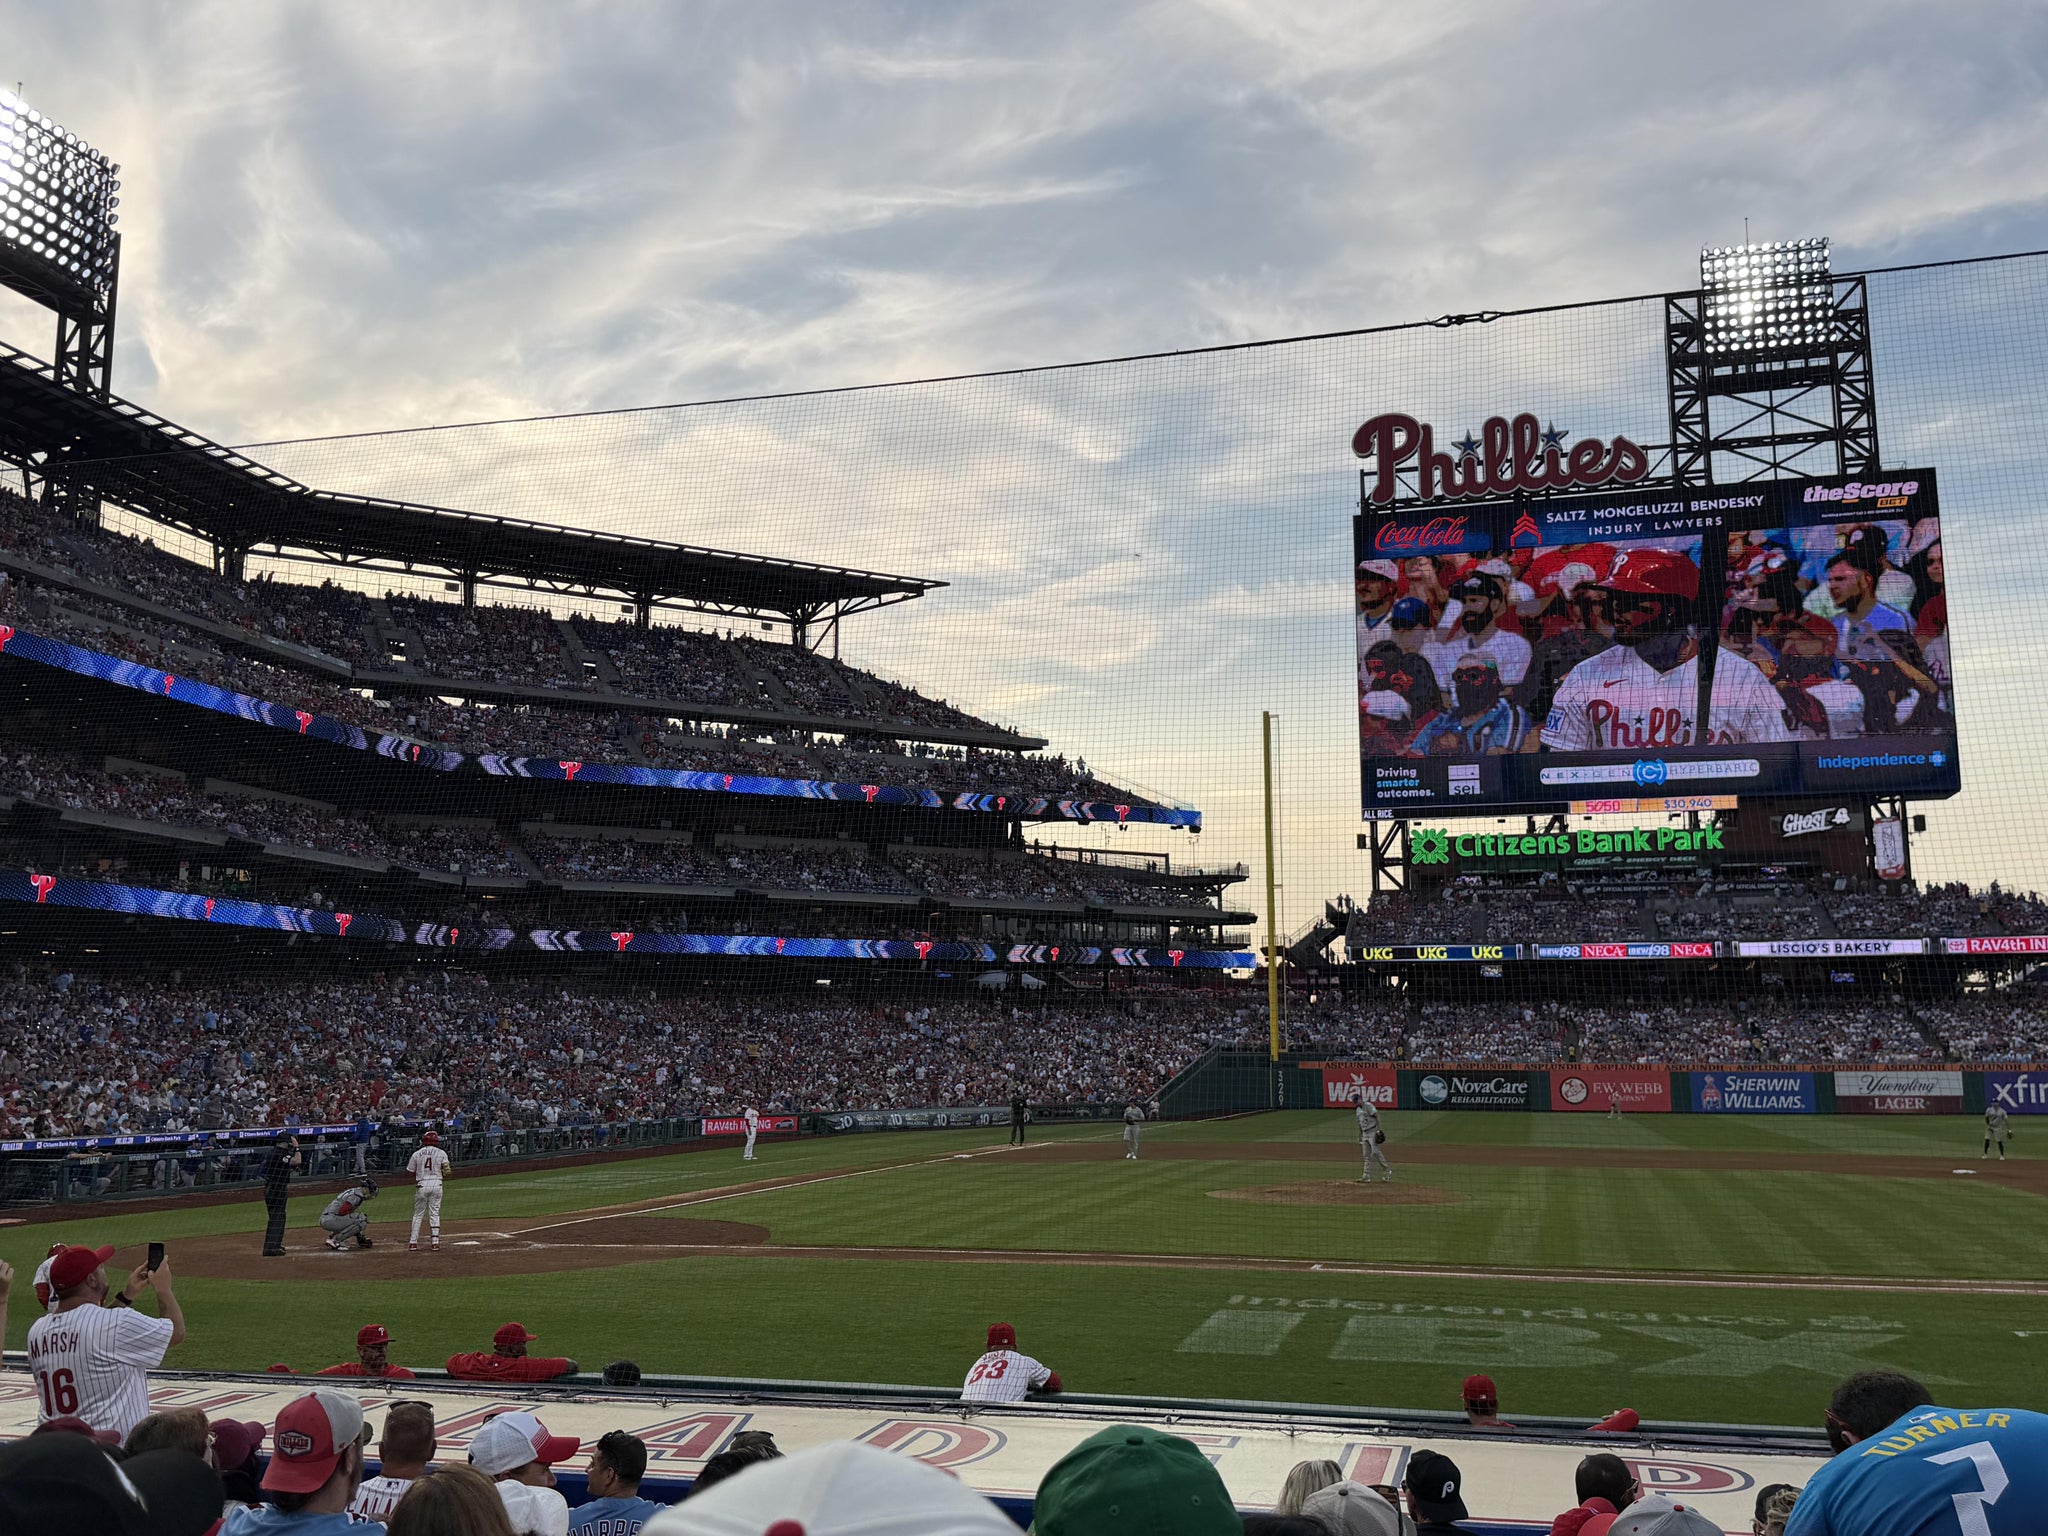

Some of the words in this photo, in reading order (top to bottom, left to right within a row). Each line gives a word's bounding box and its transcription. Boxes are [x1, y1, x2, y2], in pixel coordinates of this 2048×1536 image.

[1352, 412, 1650, 505] Phillies
[1803, 481, 1919, 503] theScore
[1546, 510, 1586, 524] SALTZ
[1594, 501, 1684, 520] MONGELUZZI
[1690, 495, 1764, 512] BENDESKY
[1588, 523, 1642, 536] INJURY
[1654, 516, 1722, 530] LAWYERS
[1670, 762, 1758, 774] HYPERBARIC
[1818, 753, 1926, 769] Independence
[1376, 768, 1417, 778] Driving
[1376, 778, 1420, 788] smarter
[1377, 788, 1435, 798] outcomes.
[1664, 798, 1712, 809] $30,940
[1363, 810, 1376, 818] ALL
[1782, 808, 1836, 837] GHOST
[1455, 831, 1570, 858] Citizens
[1577, 826, 1652, 854] Bank
[1657, 824, 1724, 851] Park
[1362, 948, 1394, 960] UKG
[1416, 947, 1448, 960] UKG
[1471, 946, 1503, 960] UKG
[1584, 946, 1624, 957] NECA
[1674, 944, 1712, 956] NECA
[1770, 944, 1829, 953] LISCIO'S
[1834, 942, 1890, 952] BAKERY
[1970, 938, 2026, 952] RAV4th
[2030, 938, 2048, 951] IN
[1328, 1081, 1393, 1103] Wawa
[1450, 1077, 1528, 1094] NovaCare
[1620, 1082, 1662, 1094] WEBB
[1725, 1076, 1800, 1092] SHERWIN
[1858, 1075, 1938, 1094] Yuengling
[1450, 1095, 1525, 1104] REHABILITATION
[1874, 1097, 1926, 1110] LAGER
[707, 1120, 738, 1132] RAV4th
[740, 1120, 771, 1132] INNG
[424, 1157, 432, 1170] 4
[30, 1332, 78, 1360] MARSH
[968, 1360, 1008, 1386] 33
[40, 1368, 78, 1417] 16
[1860, 1413, 2010, 1457] TURNER
[568, 1518, 642, 1536] ARPE
